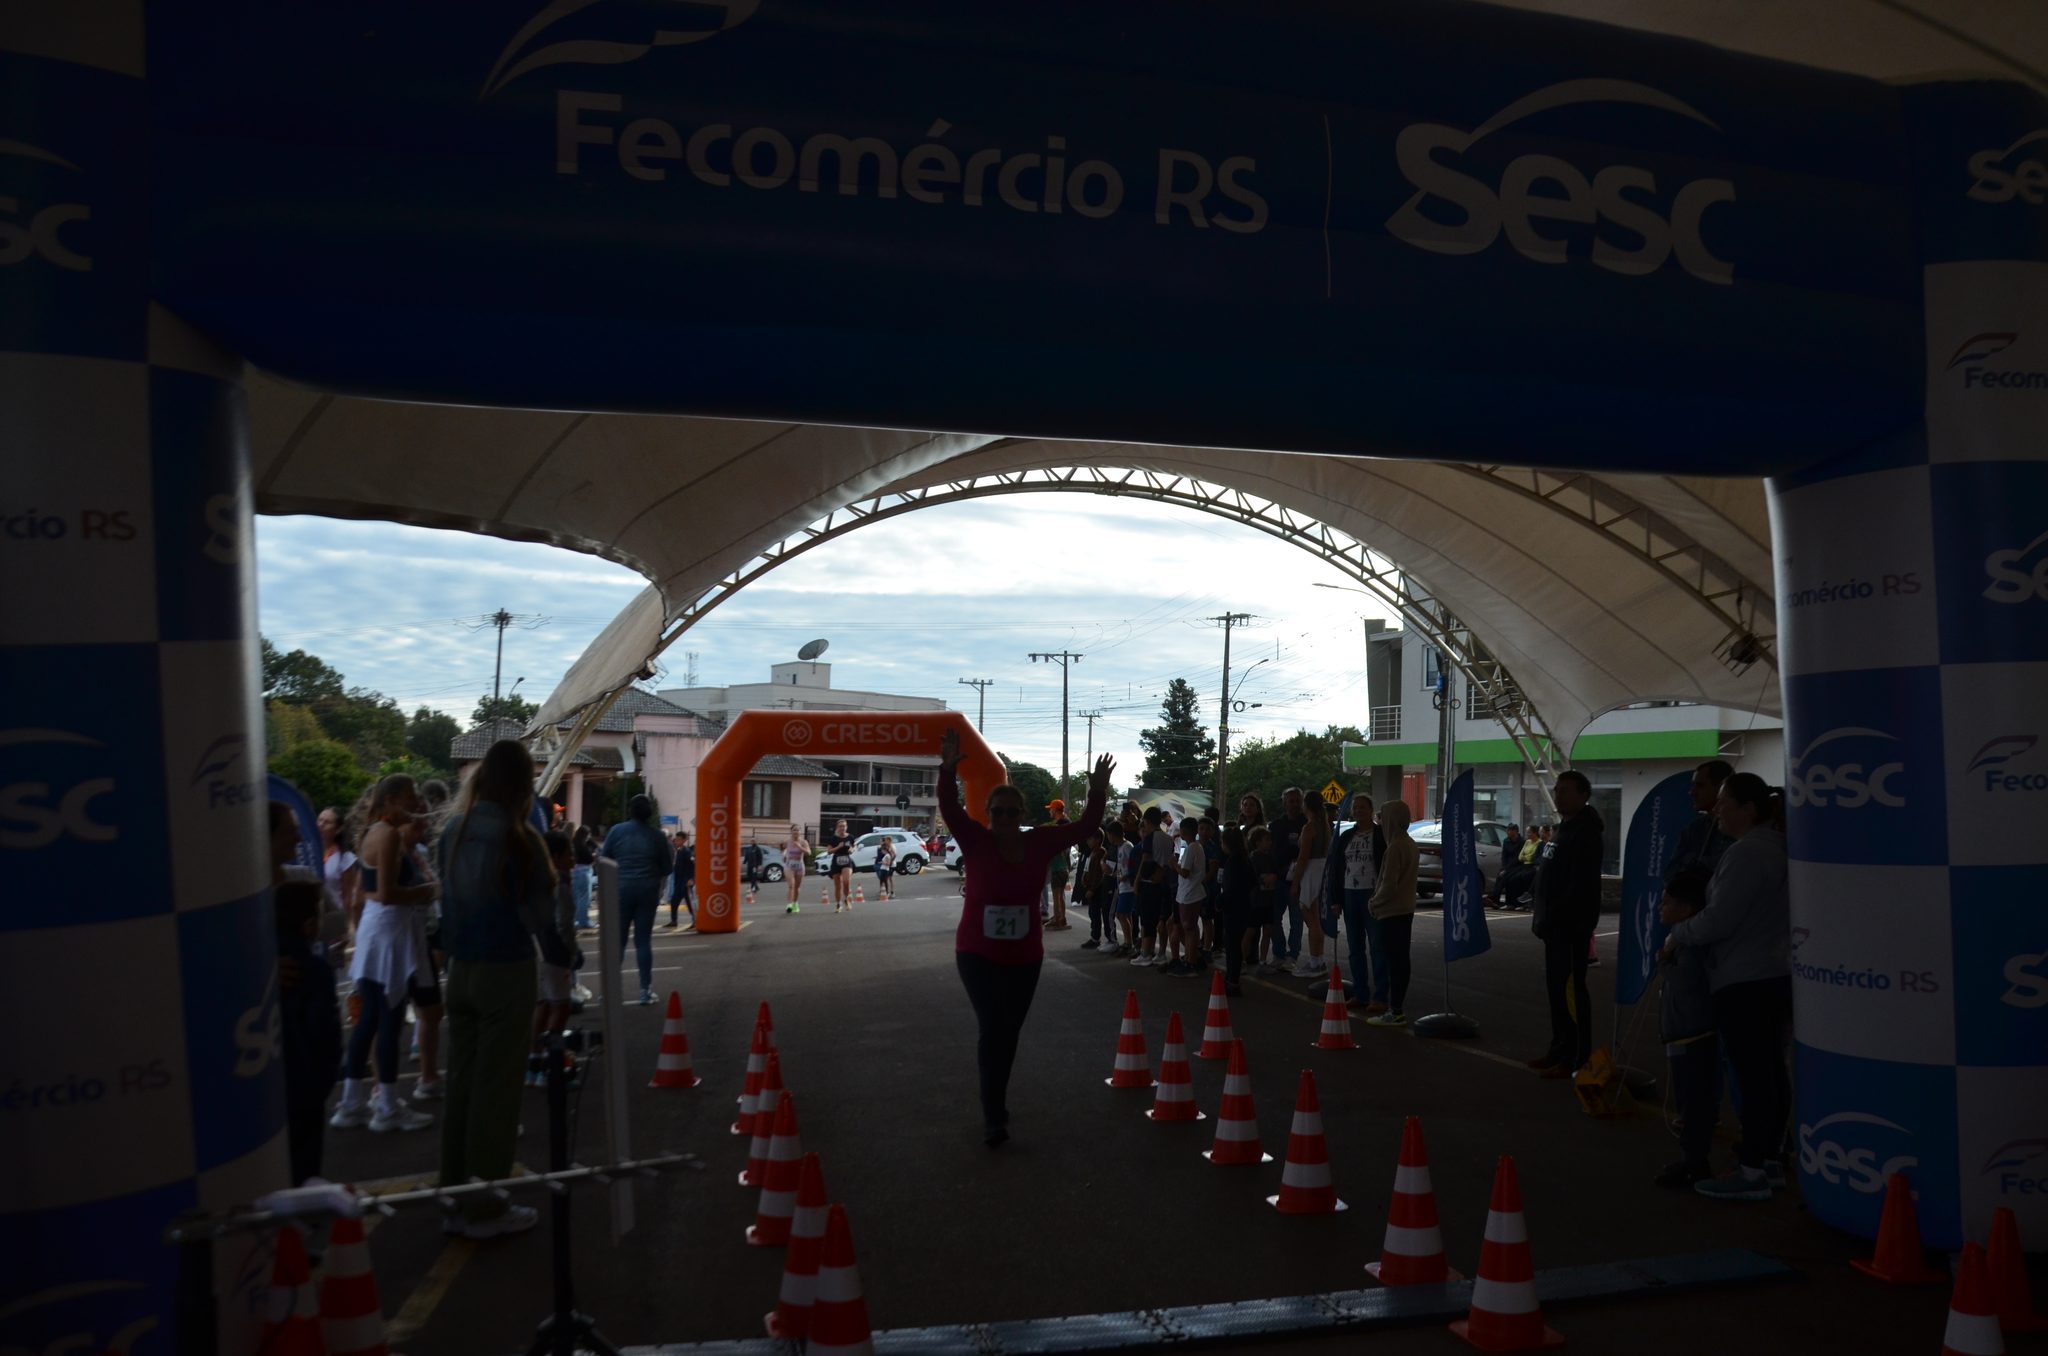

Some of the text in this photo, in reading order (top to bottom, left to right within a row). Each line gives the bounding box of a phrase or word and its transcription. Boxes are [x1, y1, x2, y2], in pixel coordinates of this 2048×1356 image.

[555, 89, 1269, 234] Fecomércio RS
[1384, 121, 1737, 286] Sesc
[81, 509, 137, 541] RS
[1882, 572, 1922, 597] RS
[820, 722, 929, 745] CRESOL
[710, 796, 729, 887] CRESOL
[995, 917, 1016, 936] 21
[1900, 969, 1940, 994] RS
[119, 1058, 172, 1096] RS
